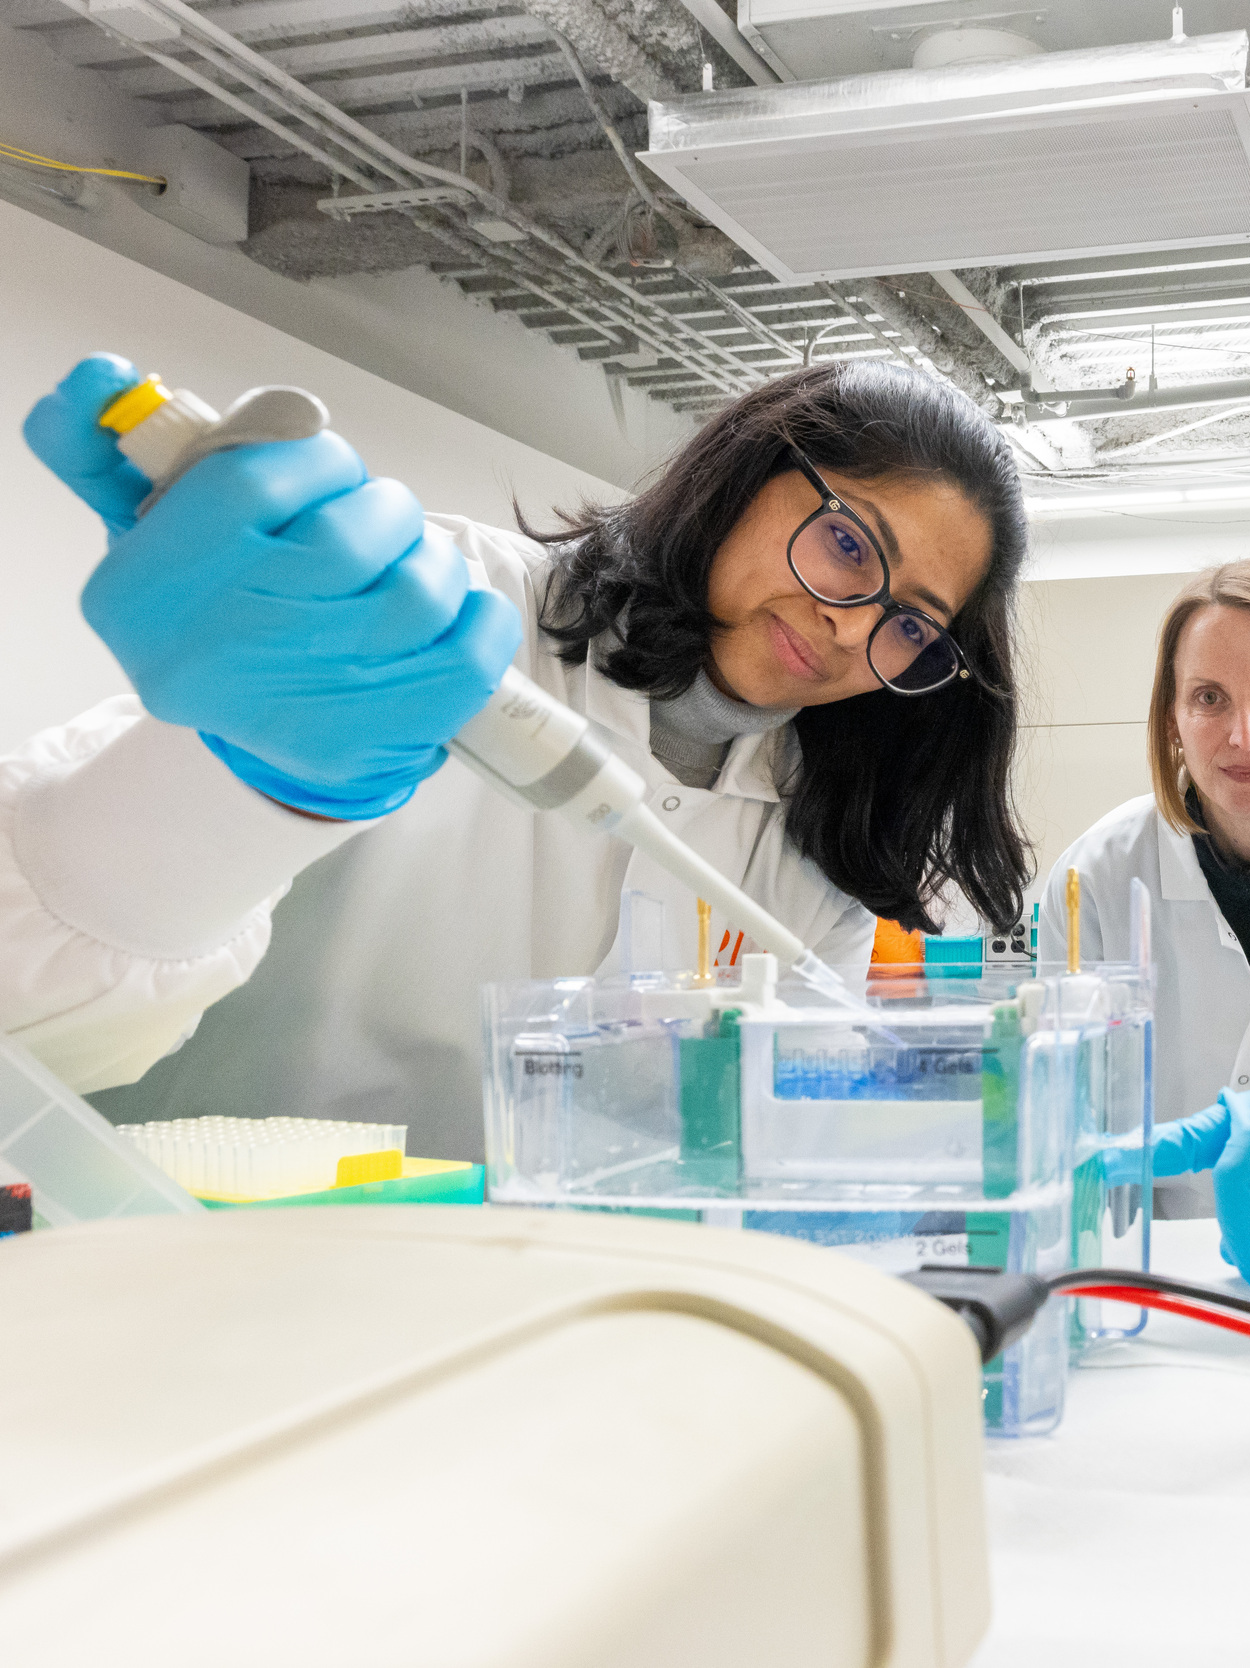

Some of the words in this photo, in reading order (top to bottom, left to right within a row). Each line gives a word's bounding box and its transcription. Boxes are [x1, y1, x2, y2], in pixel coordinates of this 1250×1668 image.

[524, 1059, 583, 1079] Blotting
[917, 1240, 926, 1257] 2
[933, 1239, 973, 1258] Gels
